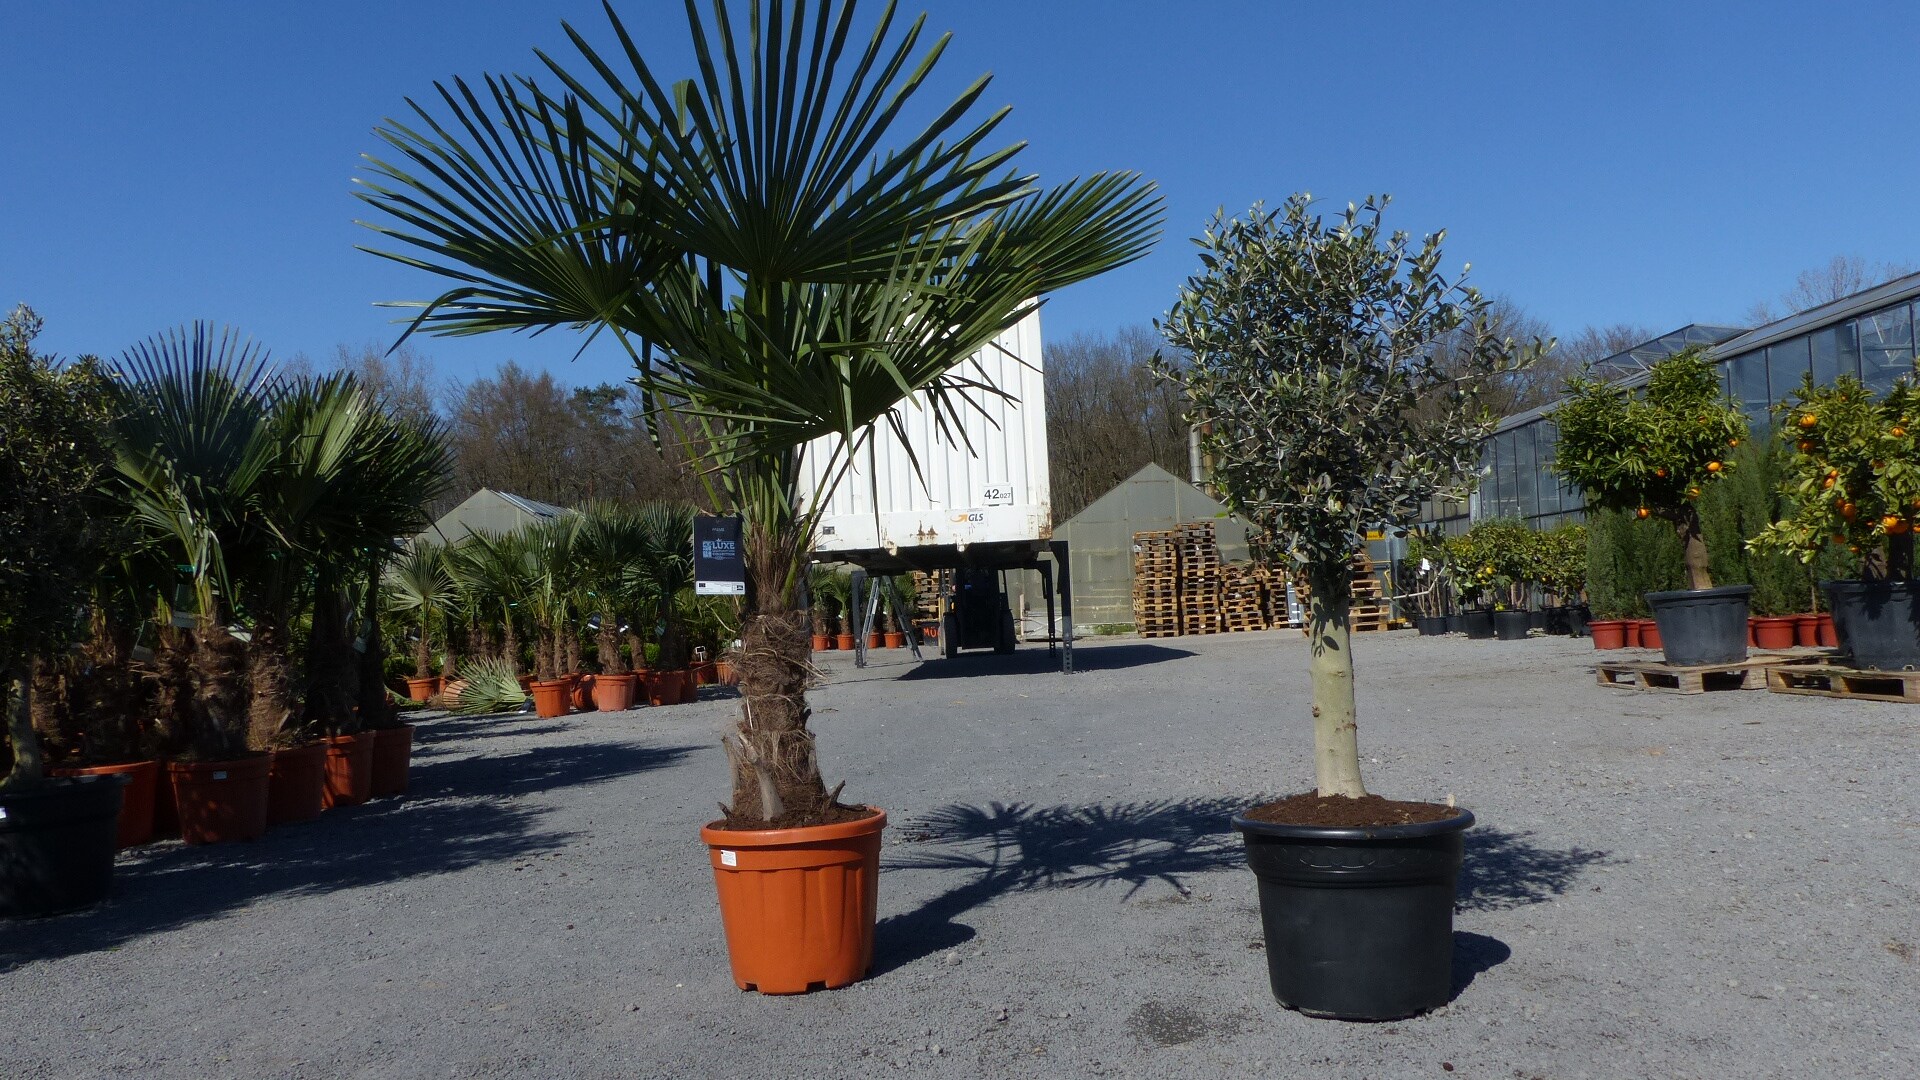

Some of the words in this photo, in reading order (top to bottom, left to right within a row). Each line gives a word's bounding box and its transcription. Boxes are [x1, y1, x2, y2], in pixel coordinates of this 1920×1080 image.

[968, 513, 984, 522] GLS
[712, 542, 735, 550] LUXE
[923, 626, 940, 638] MÜ
